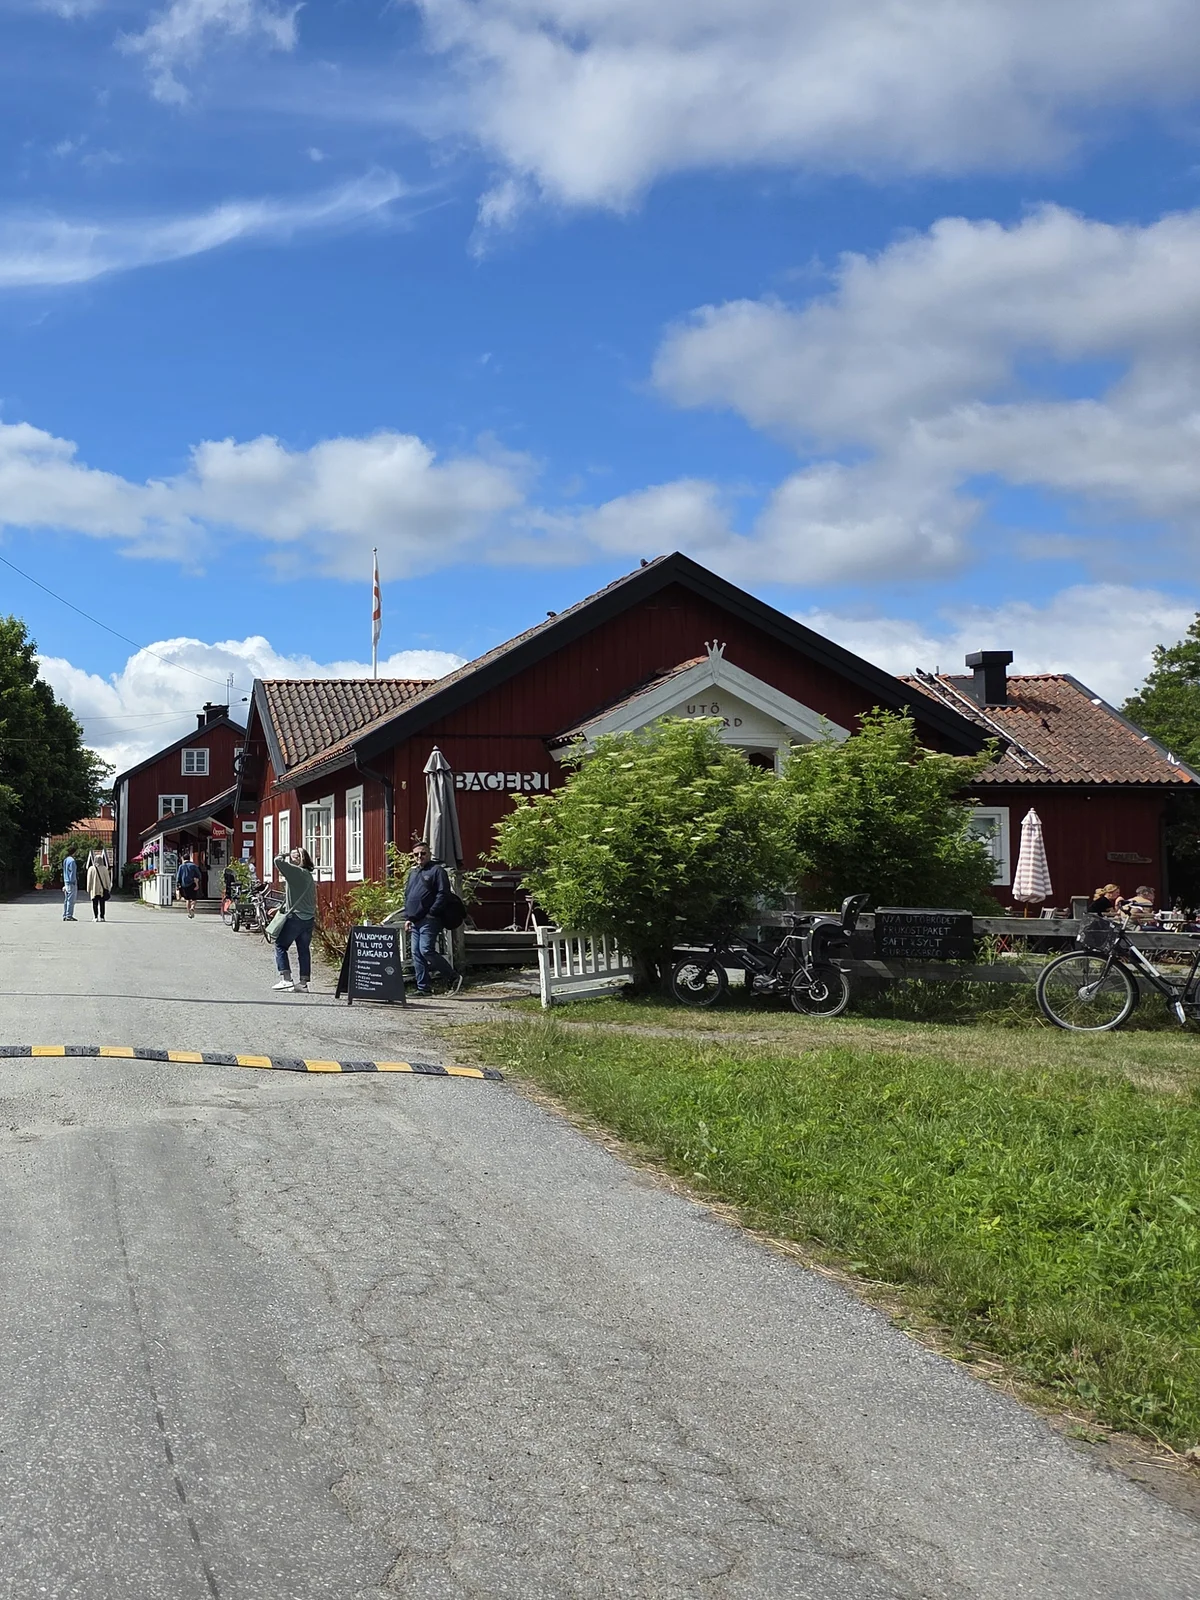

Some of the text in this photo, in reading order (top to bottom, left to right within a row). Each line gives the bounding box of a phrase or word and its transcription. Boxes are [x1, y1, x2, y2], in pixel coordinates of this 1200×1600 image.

[687, 702, 720, 715] UTÖ
[453, 771, 550, 791] BAGERI
[212, 827, 225, 836] Öppet
[881, 915, 901, 923] NYA
[354, 931, 394, 941] VÄLKOMMEN
[355, 941, 370, 949] TILL
[882, 937, 907, 946] SAFT
[916, 938, 943, 948] SYLT
